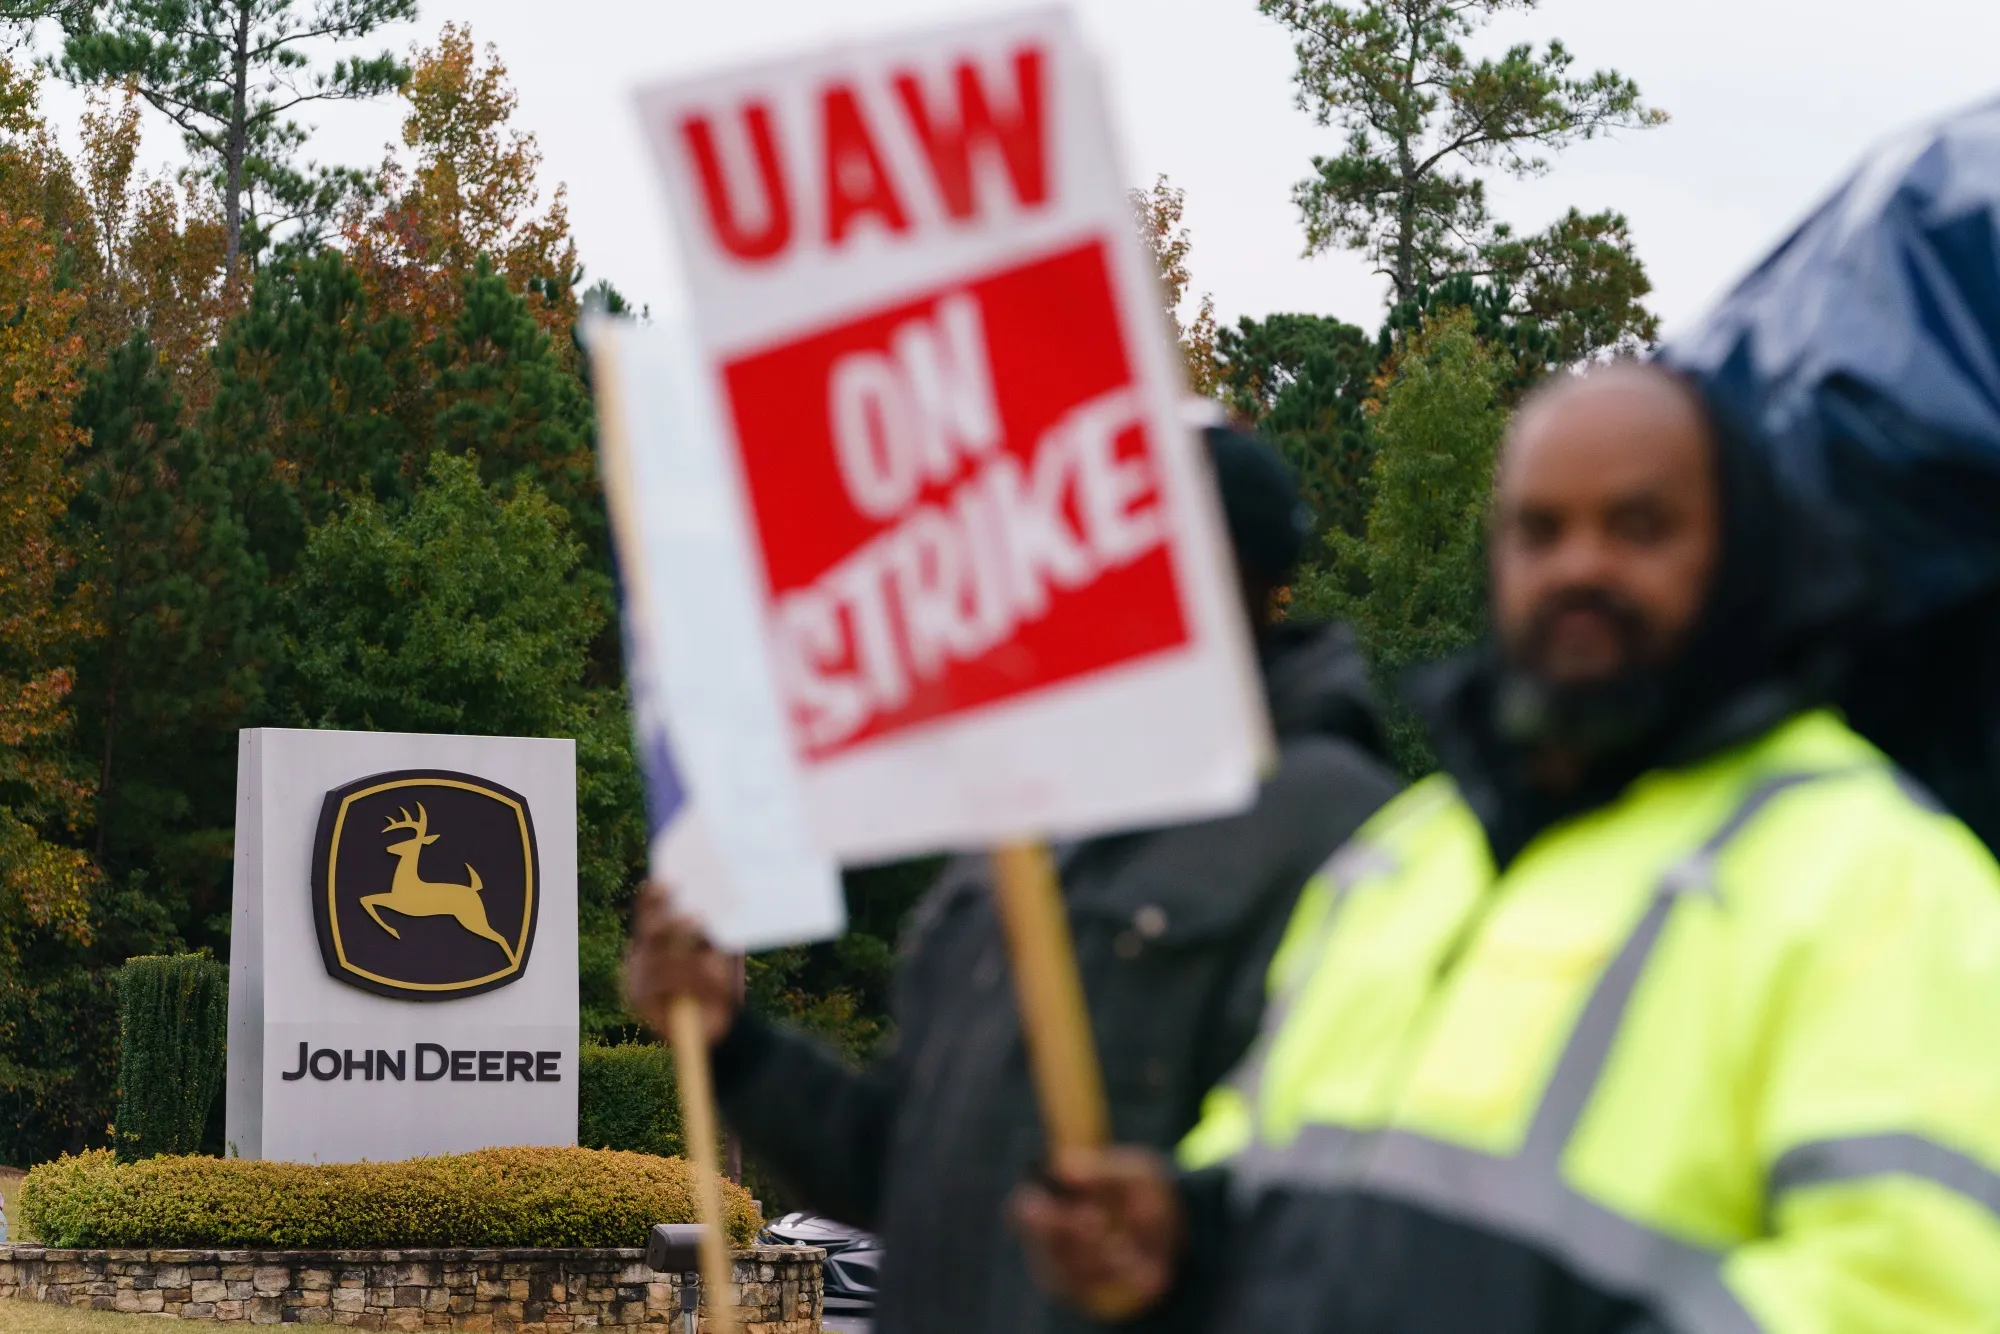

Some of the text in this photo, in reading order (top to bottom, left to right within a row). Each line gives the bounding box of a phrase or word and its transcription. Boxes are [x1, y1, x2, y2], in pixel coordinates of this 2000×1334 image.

[679, 45, 1048, 264] UAW
[827, 287, 996, 521] ON
[773, 387, 1167, 749] STRIKE
[282, 1041, 561, 1082] JOHN DEERE
